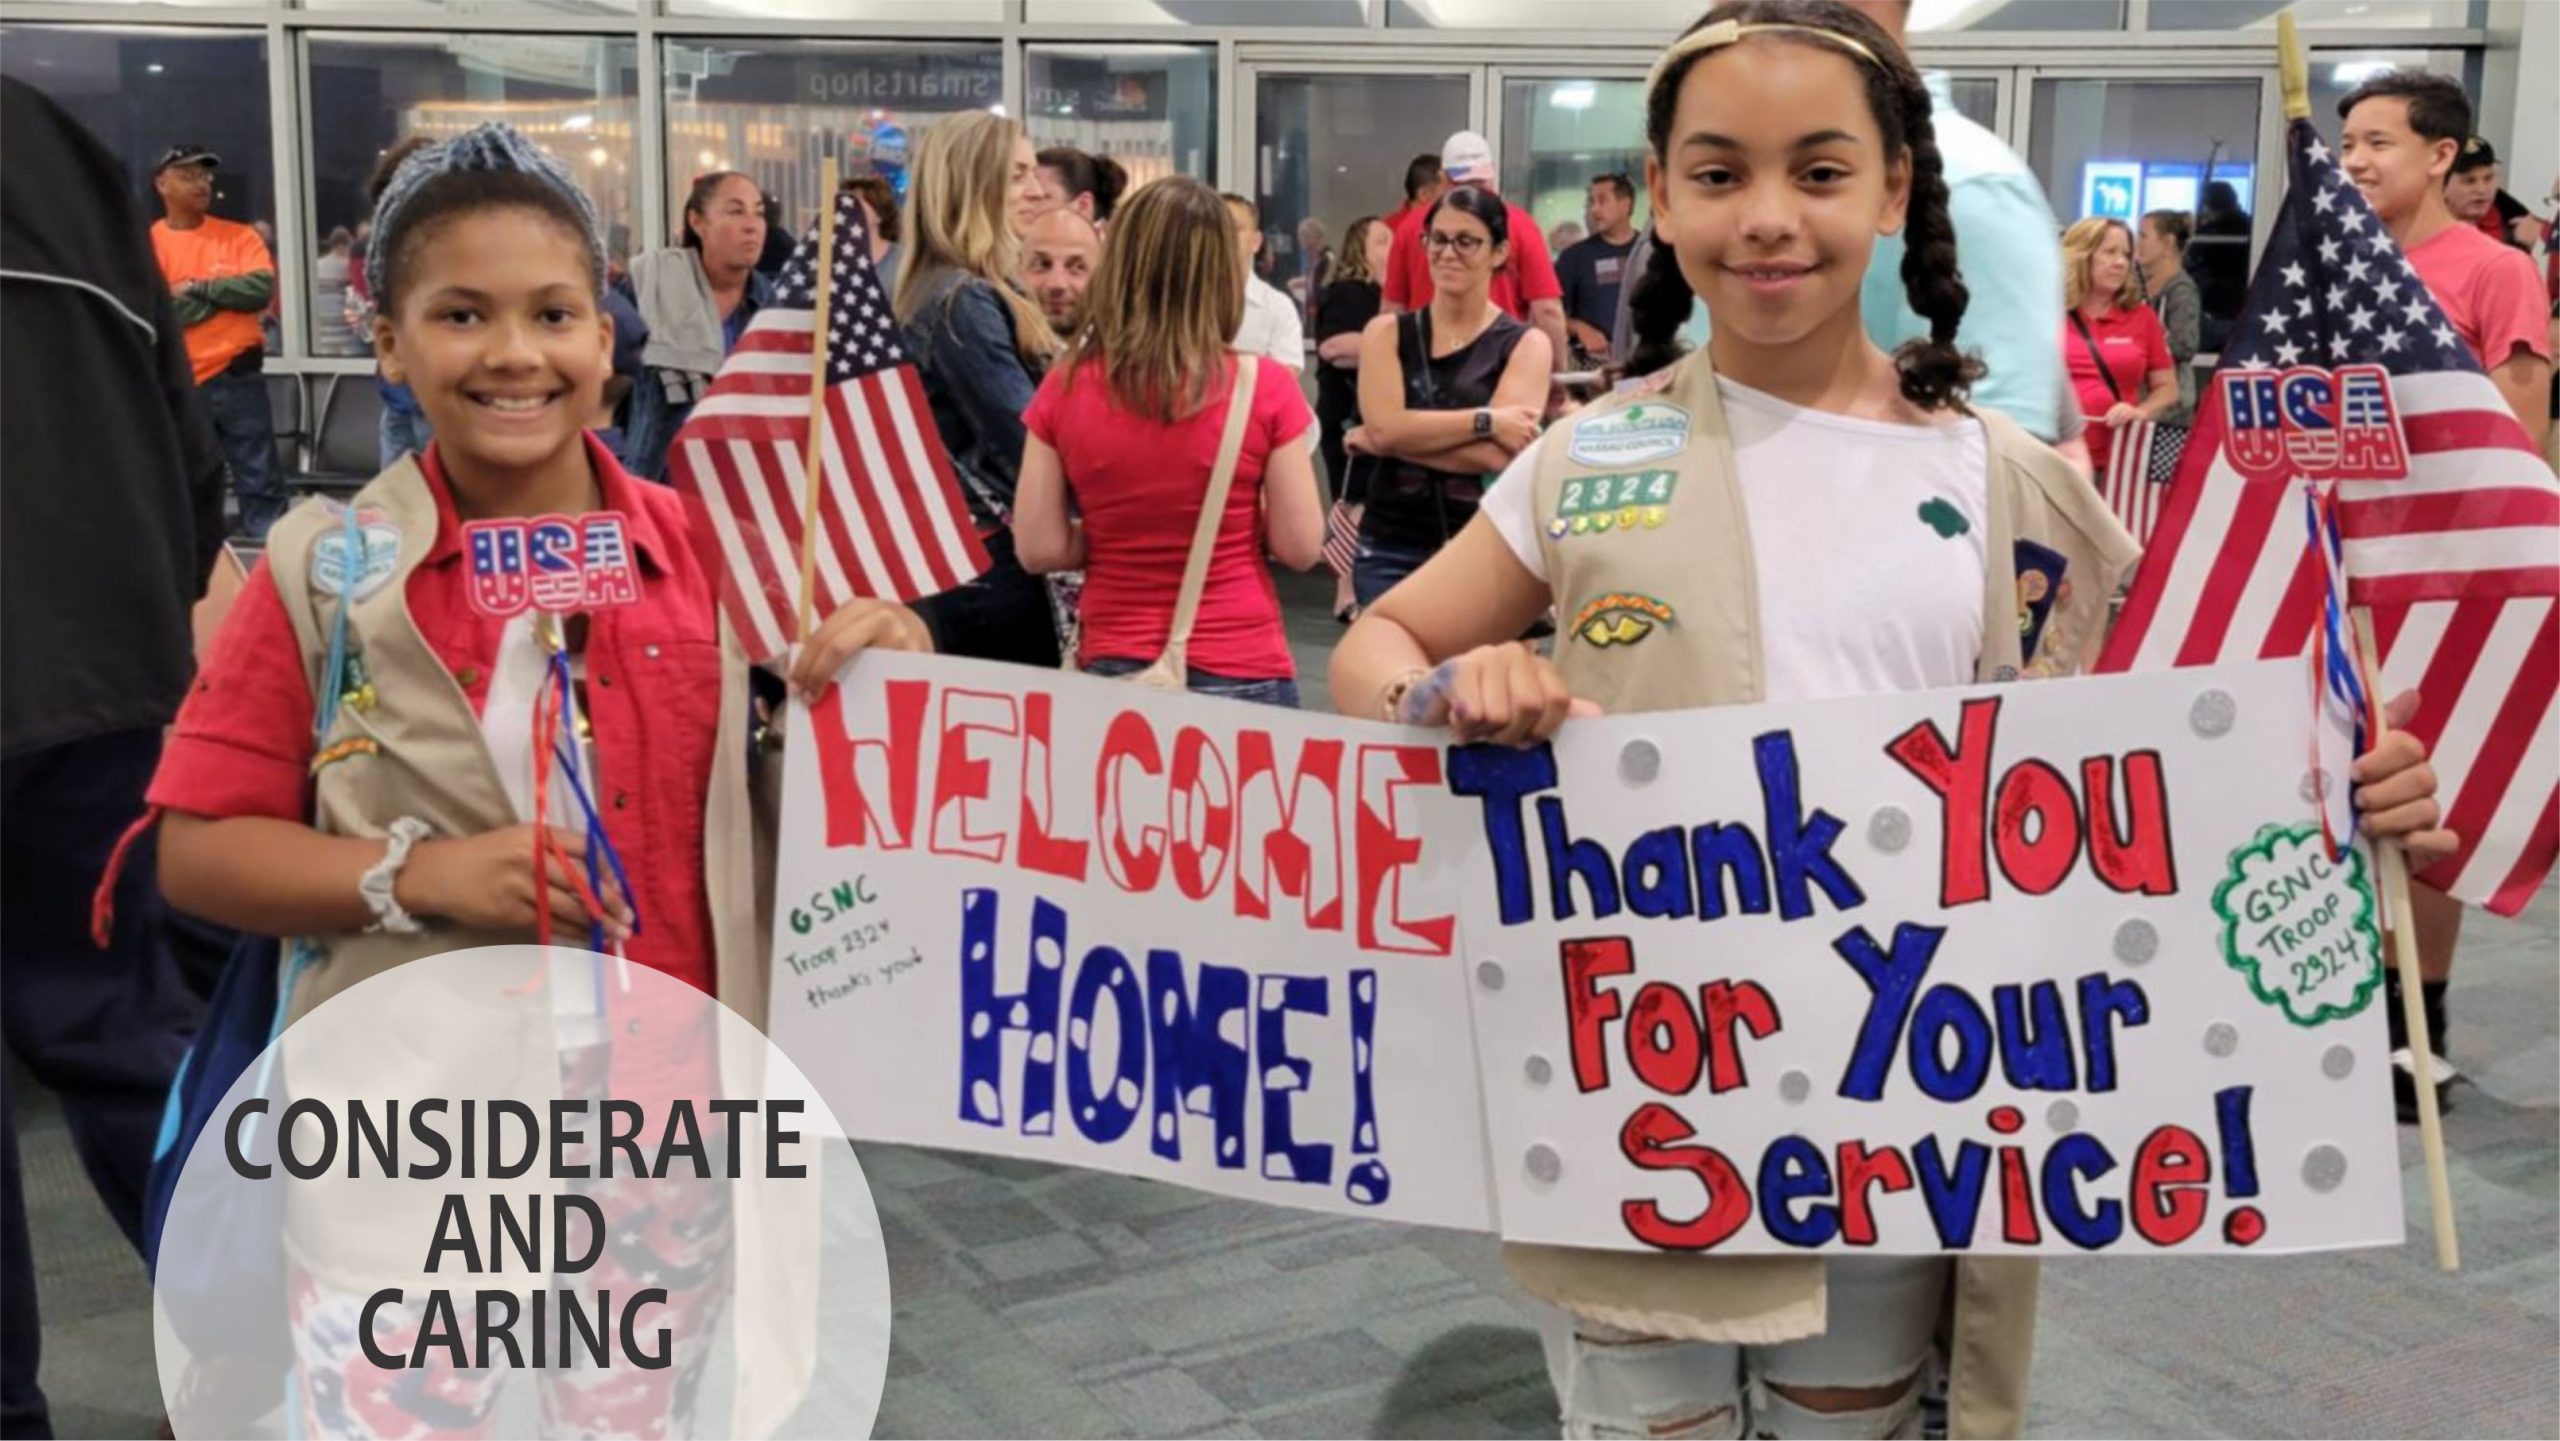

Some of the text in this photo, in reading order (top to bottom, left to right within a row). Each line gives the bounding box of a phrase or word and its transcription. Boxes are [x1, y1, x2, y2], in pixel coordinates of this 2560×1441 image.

[2221, 370, 2402, 471] USA
[1561, 473, 1669, 510] 2324
[471, 519, 638, 614] USA
[809, 680, 1455, 956] WELCOME
[1447, 697, 2179, 925] Thank You
[790, 874, 878, 935] GSNC
[2245, 853, 2331, 923] GSNC
[2256, 893, 2339, 957] TROOP
[959, 889, 1391, 1205] HOME!
[1559, 922, 2150, 1103] For Your
[1620, 1084, 2267, 1250] Service!
